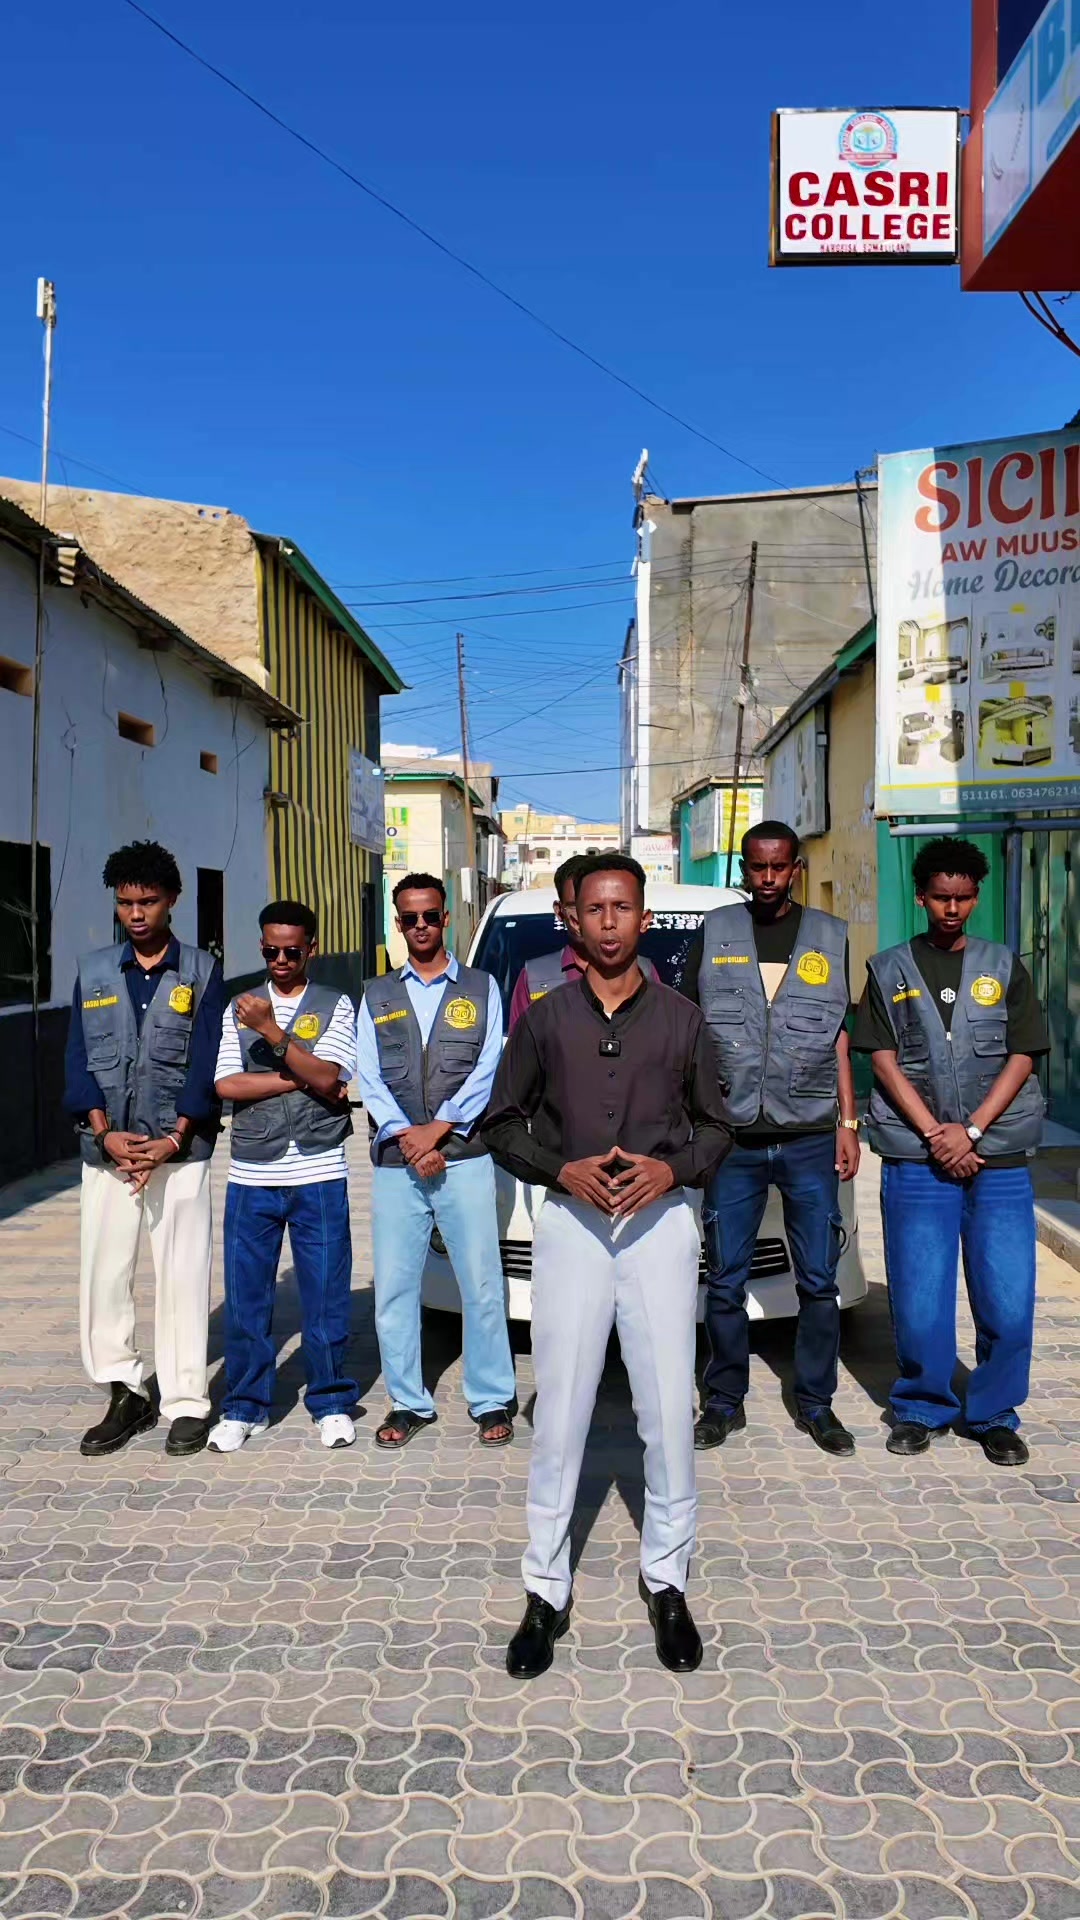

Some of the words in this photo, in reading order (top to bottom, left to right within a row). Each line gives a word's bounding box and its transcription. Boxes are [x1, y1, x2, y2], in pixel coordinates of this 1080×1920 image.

[788, 171, 949, 207] CASRI
[785, 213, 951, 241] COLLEGE
[941, 537, 988, 564] AW
[996, 528, 1080, 558] MUUS
[908, 567, 984, 600] Home
